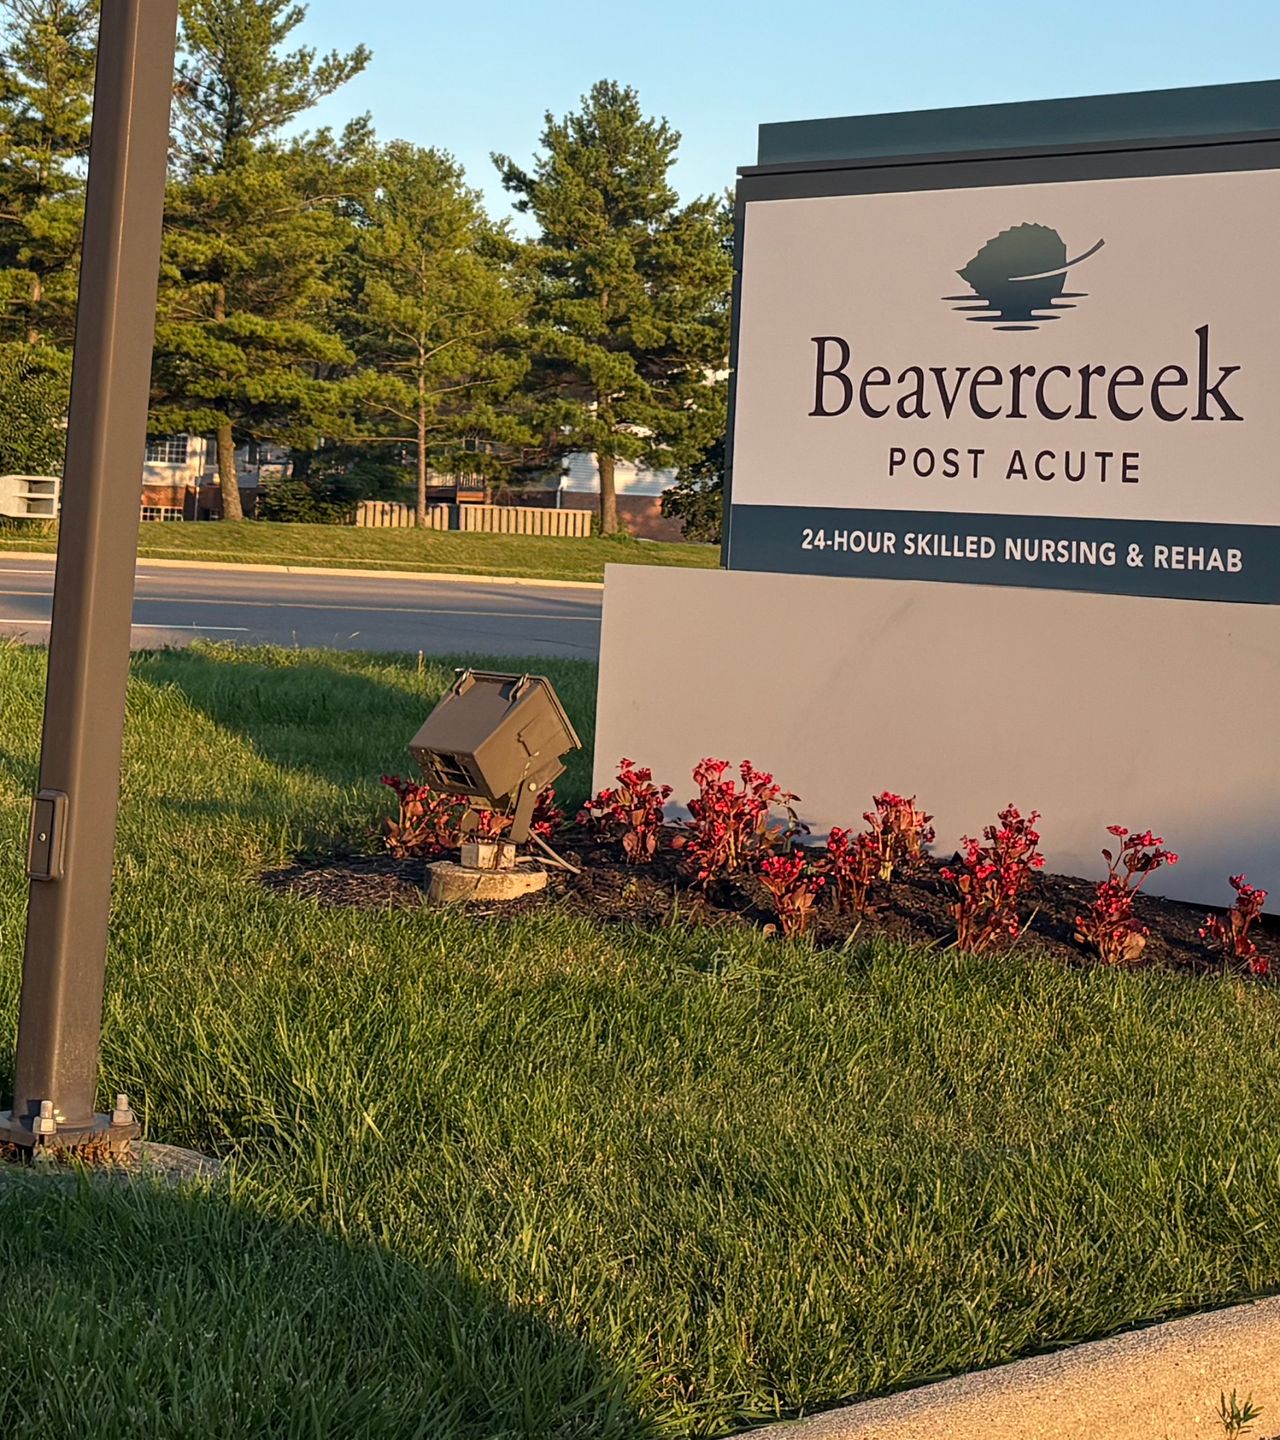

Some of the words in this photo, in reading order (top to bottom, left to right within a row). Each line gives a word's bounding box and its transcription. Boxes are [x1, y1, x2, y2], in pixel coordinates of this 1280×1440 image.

[808, 324, 1244, 422] Beavercreek
[889, 447, 985, 479] POST
[1005, 449, 1140, 483] ACUTE
[801, 528, 897, 555] 24-HOUR
[903, 532, 996, 559] SKILLED
[1004, 537, 1117, 567] NURSING
[1126, 542, 1144, 568] &
[1153, 544, 1244, 573] REHAB
